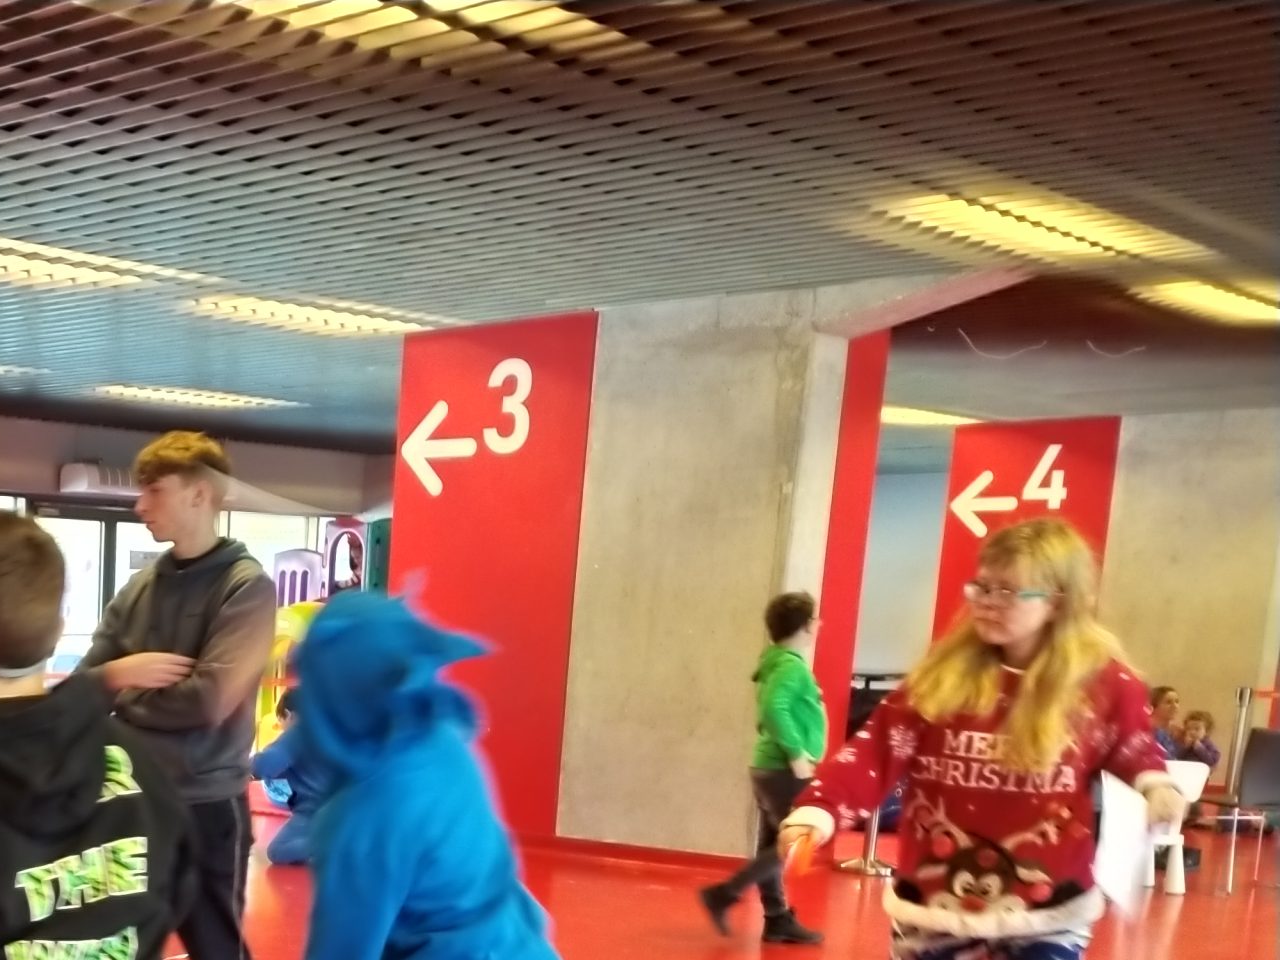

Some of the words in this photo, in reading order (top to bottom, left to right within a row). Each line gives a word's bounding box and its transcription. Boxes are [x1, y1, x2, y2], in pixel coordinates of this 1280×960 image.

[482, 357, 534, 454] 3
[1022, 443, 1069, 510] 4
[912, 756, 1077, 794] CHRISTMA
[14, 836, 149, 922] THE
